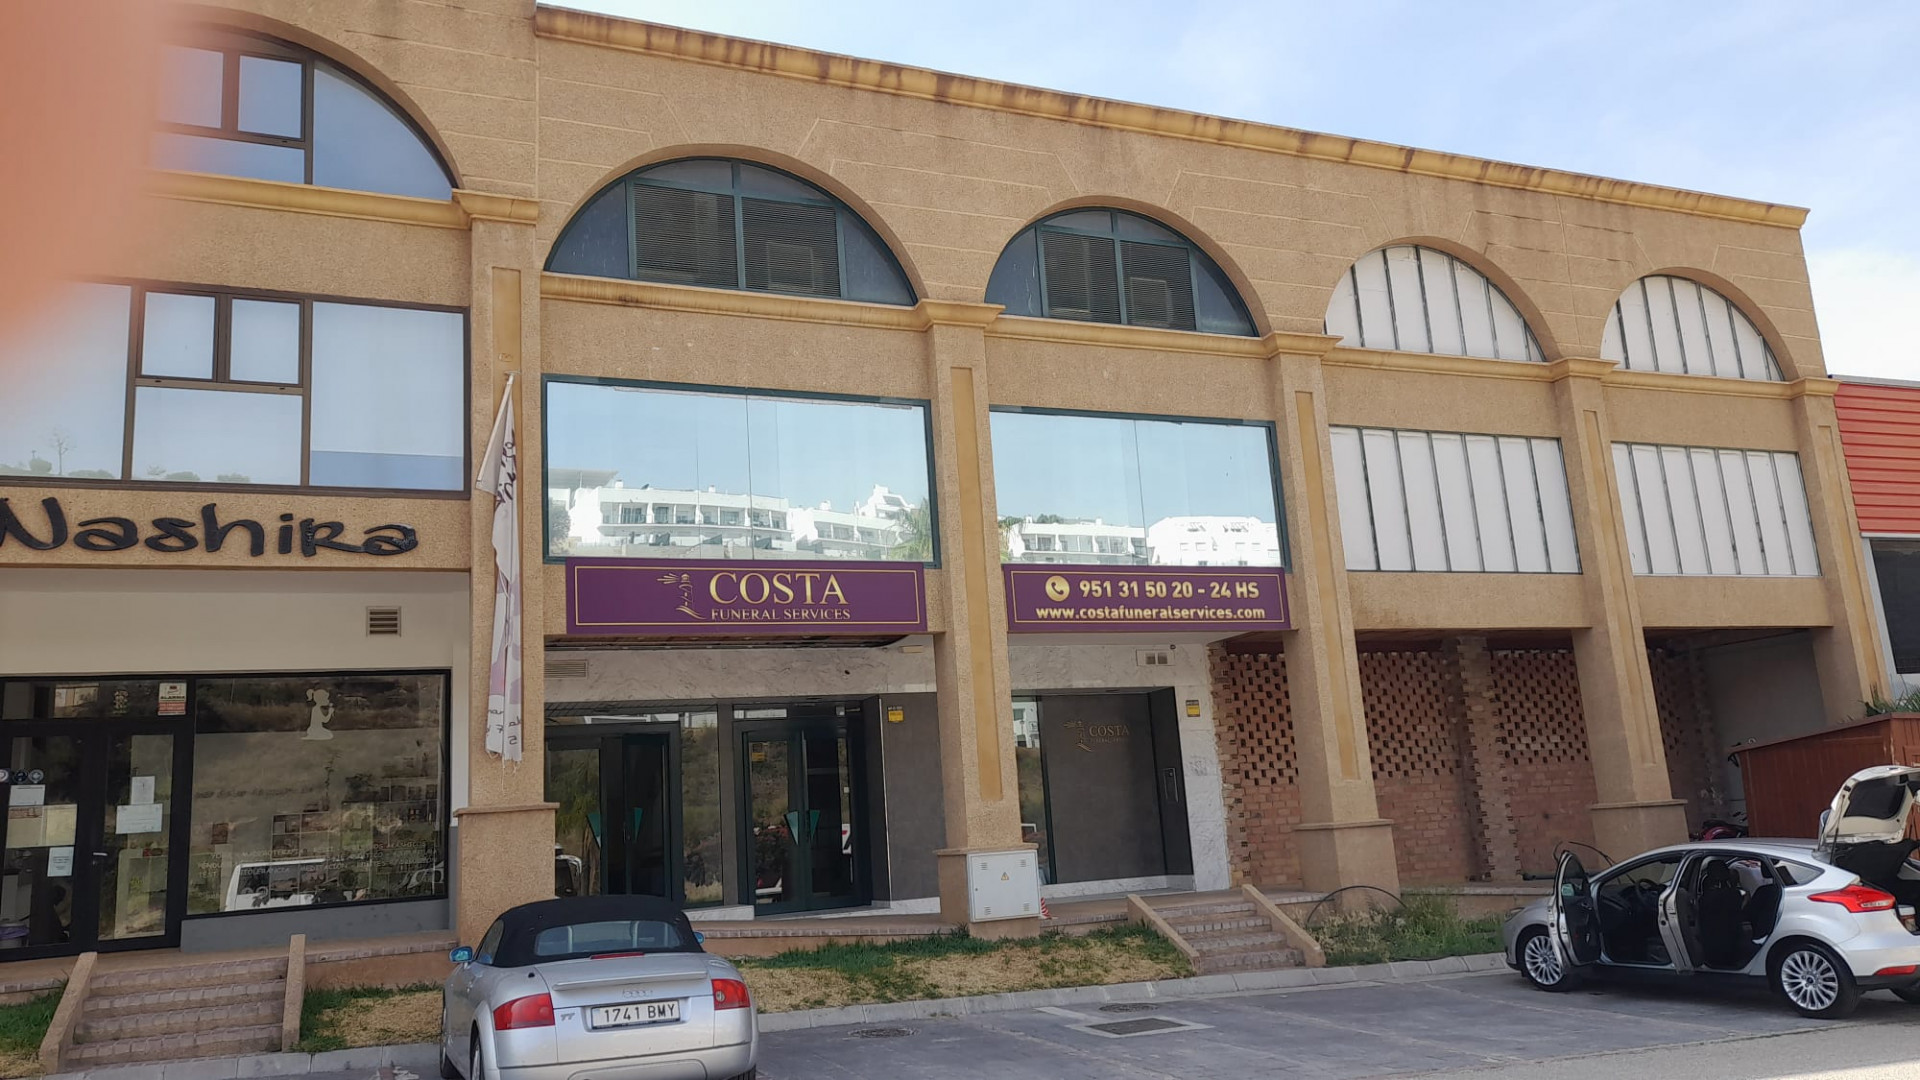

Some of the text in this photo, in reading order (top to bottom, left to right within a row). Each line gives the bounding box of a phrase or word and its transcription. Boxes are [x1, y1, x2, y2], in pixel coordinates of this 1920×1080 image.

[0, 497, 419, 557] Nashira
[708, 572, 849, 605] COSTA
[1079, 580, 1112, 598] 951
[1118, 580, 1139, 598] 31
[1145, 580, 1167, 598] 50
[1172, 581, 1193, 598] 20
[1210, 581, 1231, 599] 24
[1236, 581, 1260, 599] HS
[711, 608, 851, 621] FUNERAL SERVICES
[1036, 605, 1266, 620] www.costafuneralservices.com
[1088, 725, 1130, 736] COSTA
[604, 1006, 640, 1024] 1741
[647, 1004, 676, 1019] BMY
